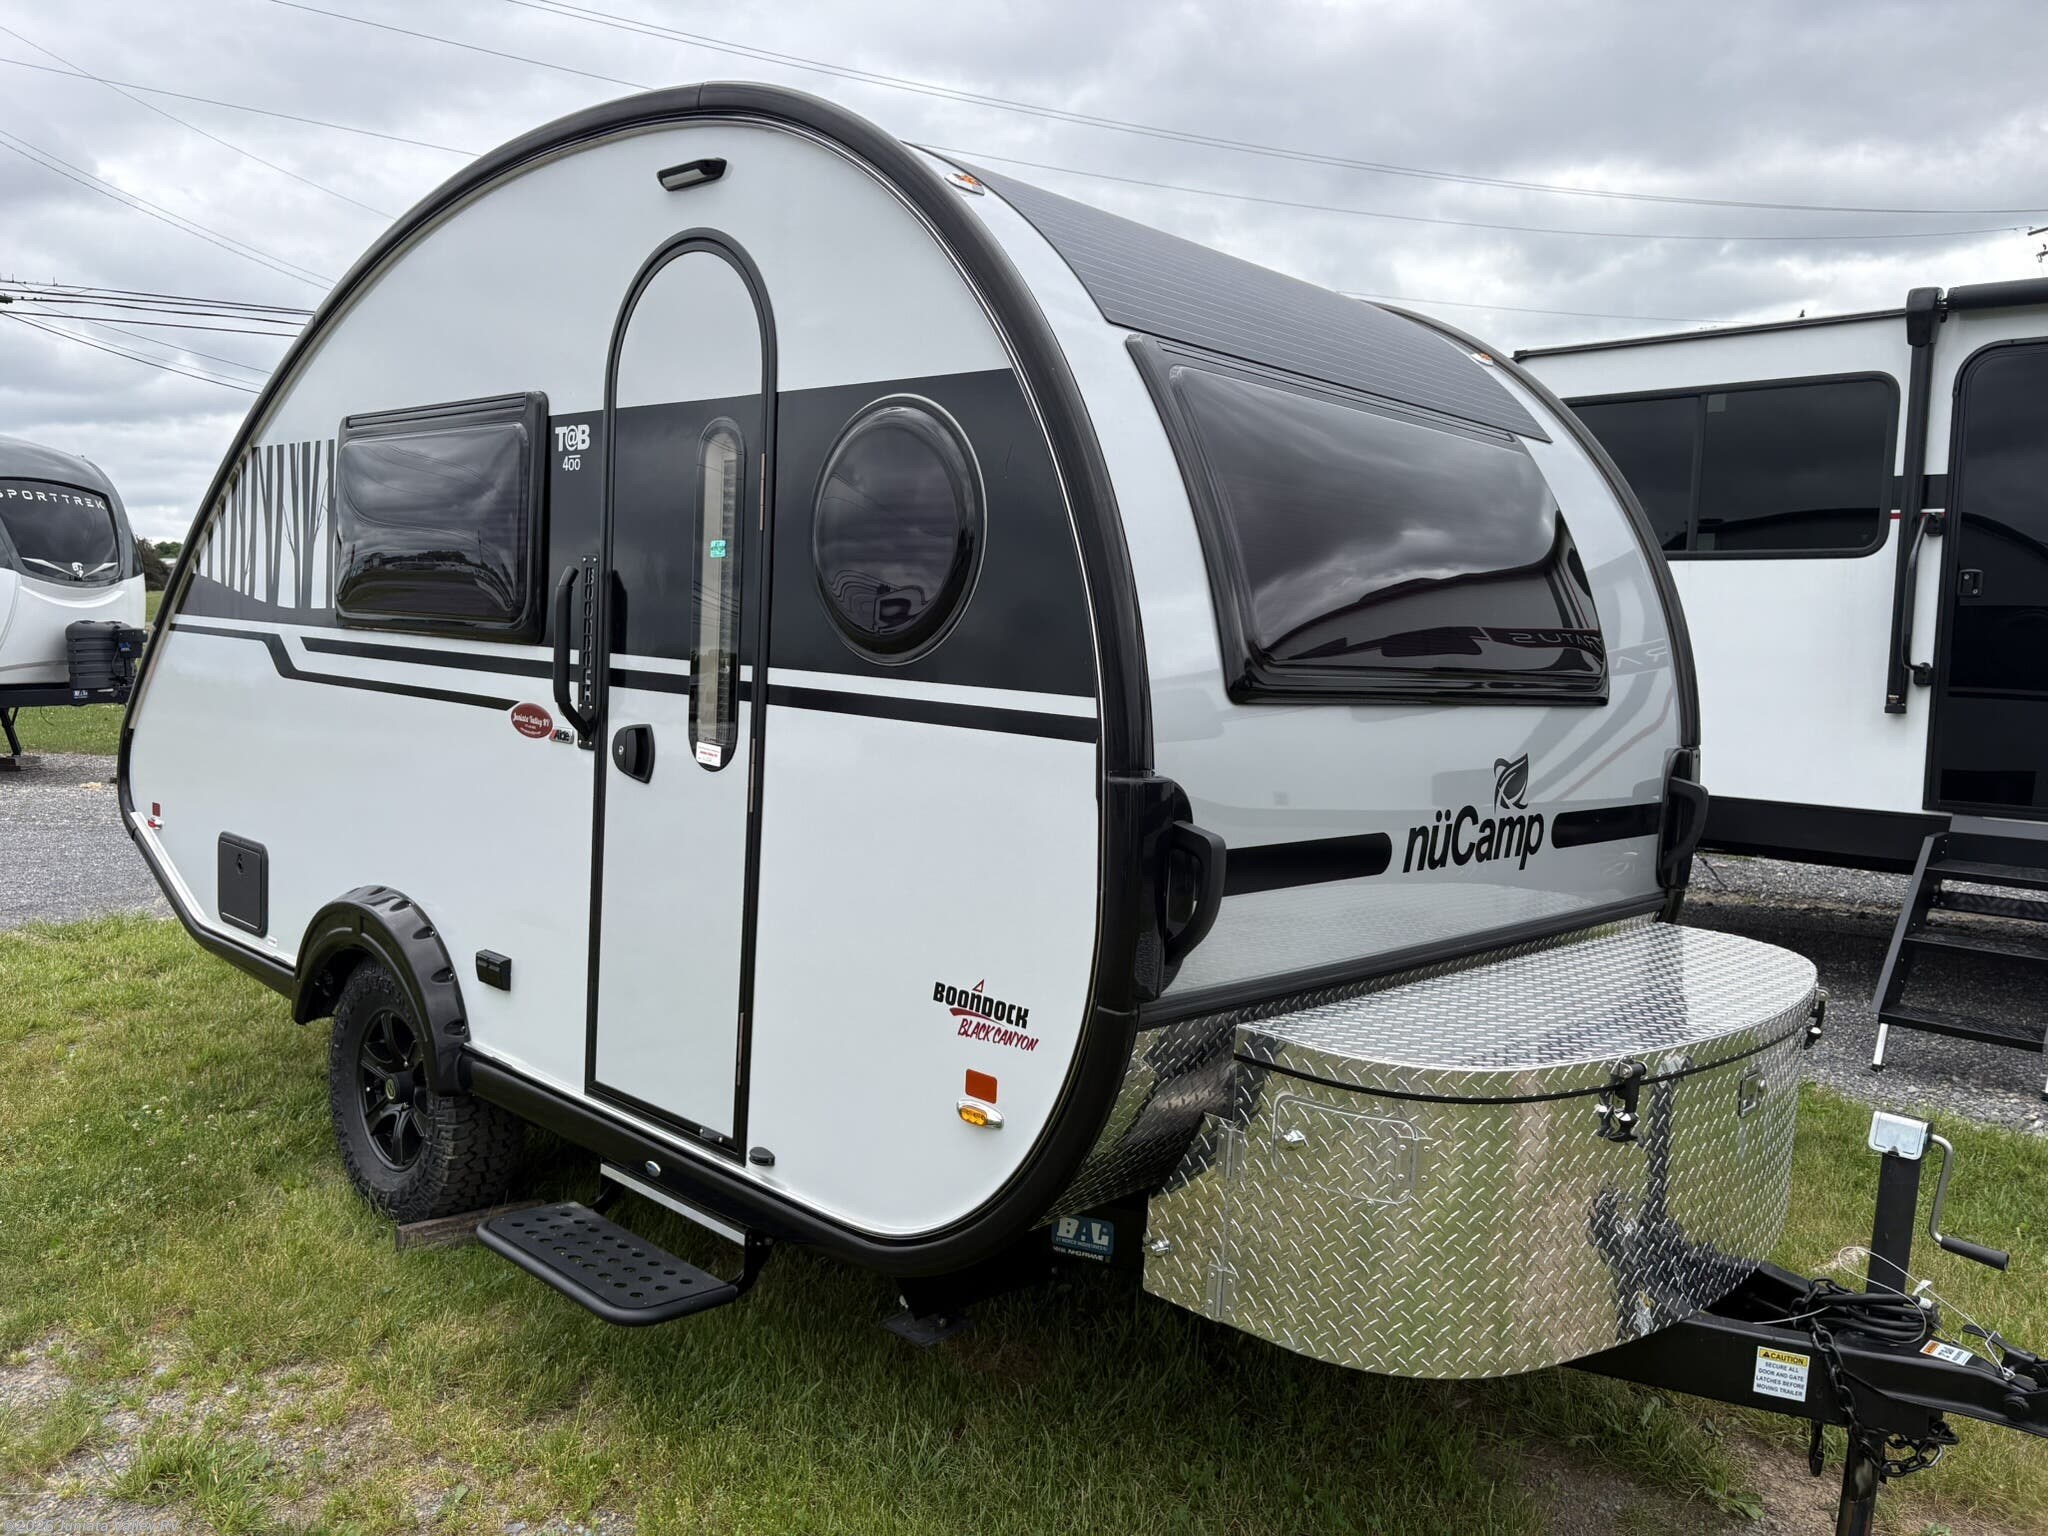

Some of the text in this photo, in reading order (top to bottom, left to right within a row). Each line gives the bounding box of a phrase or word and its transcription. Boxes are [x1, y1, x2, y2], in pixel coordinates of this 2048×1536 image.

[555, 424, 590, 452] T@B
[562, 455, 581, 471] 400
[1402, 805, 1544, 873] nüCamp
[933, 982, 1029, 1029] BOONDOCK
[957, 1018, 1039, 1051] BLACK CANYON
[1771, 1353, 1803, 1364] CAUTION
[1765, 1362, 1787, 1371] SECURE
[1756, 1376, 1804, 1389] LATCHES BEFORE
[1758, 1368, 1775, 1376] DOOR
[1789, 1374, 1804, 1382] GATE
[1756, 1383, 1803, 1396] MOVING TRAILER
